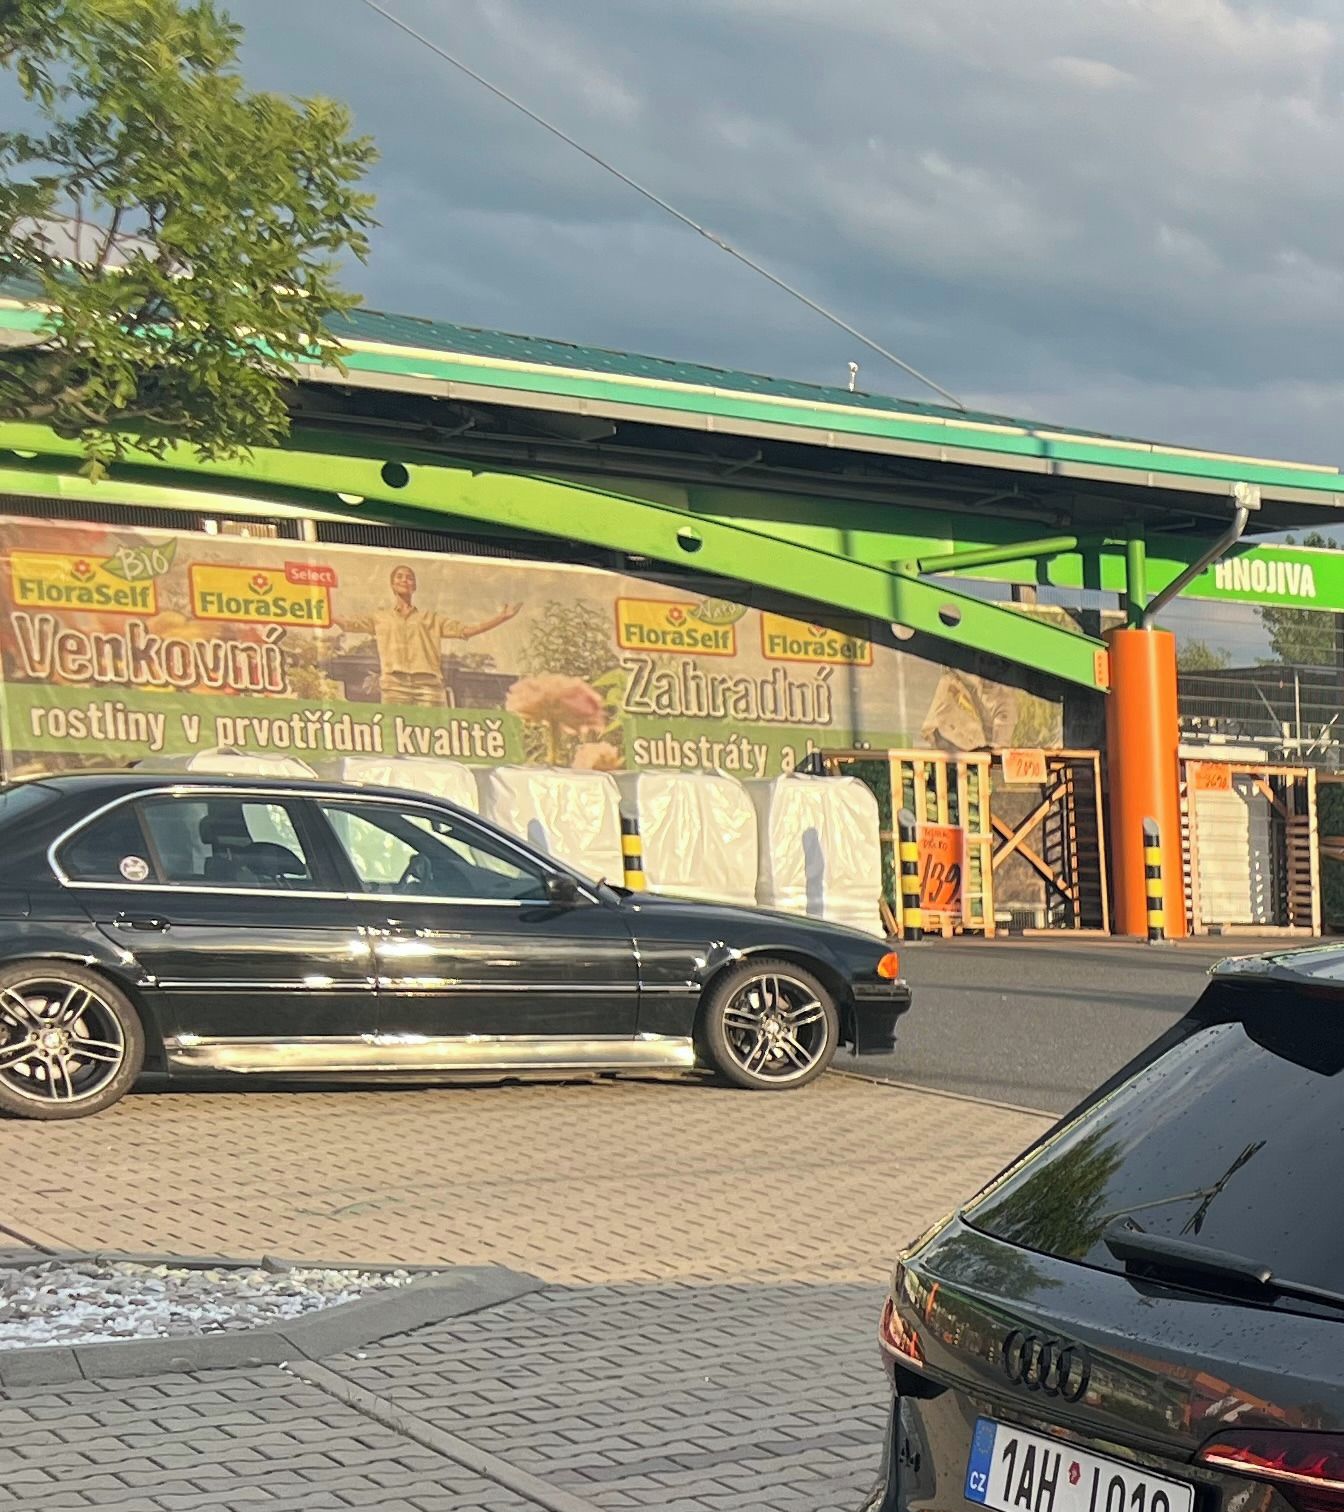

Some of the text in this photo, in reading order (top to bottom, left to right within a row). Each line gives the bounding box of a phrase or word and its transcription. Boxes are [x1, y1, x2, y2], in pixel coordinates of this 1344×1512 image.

[291, 566, 333, 583] Select
[1215, 557, 1316, 597] HNOJIVA
[19, 578, 150, 609] FloraSelf
[199, 591, 325, 620] FloraSelf
[10, 611, 289, 693] Venkovní
[624, 623, 730, 650] FloraSelf
[768, 633, 868, 661] FloraSelf
[620, 654, 834, 724] Zahradní
[30, 702, 505, 758] rostliny v prvotřídní kvalitě
[633, 732, 796, 778] substráty a
[969, 1471, 986, 1493] CZ
